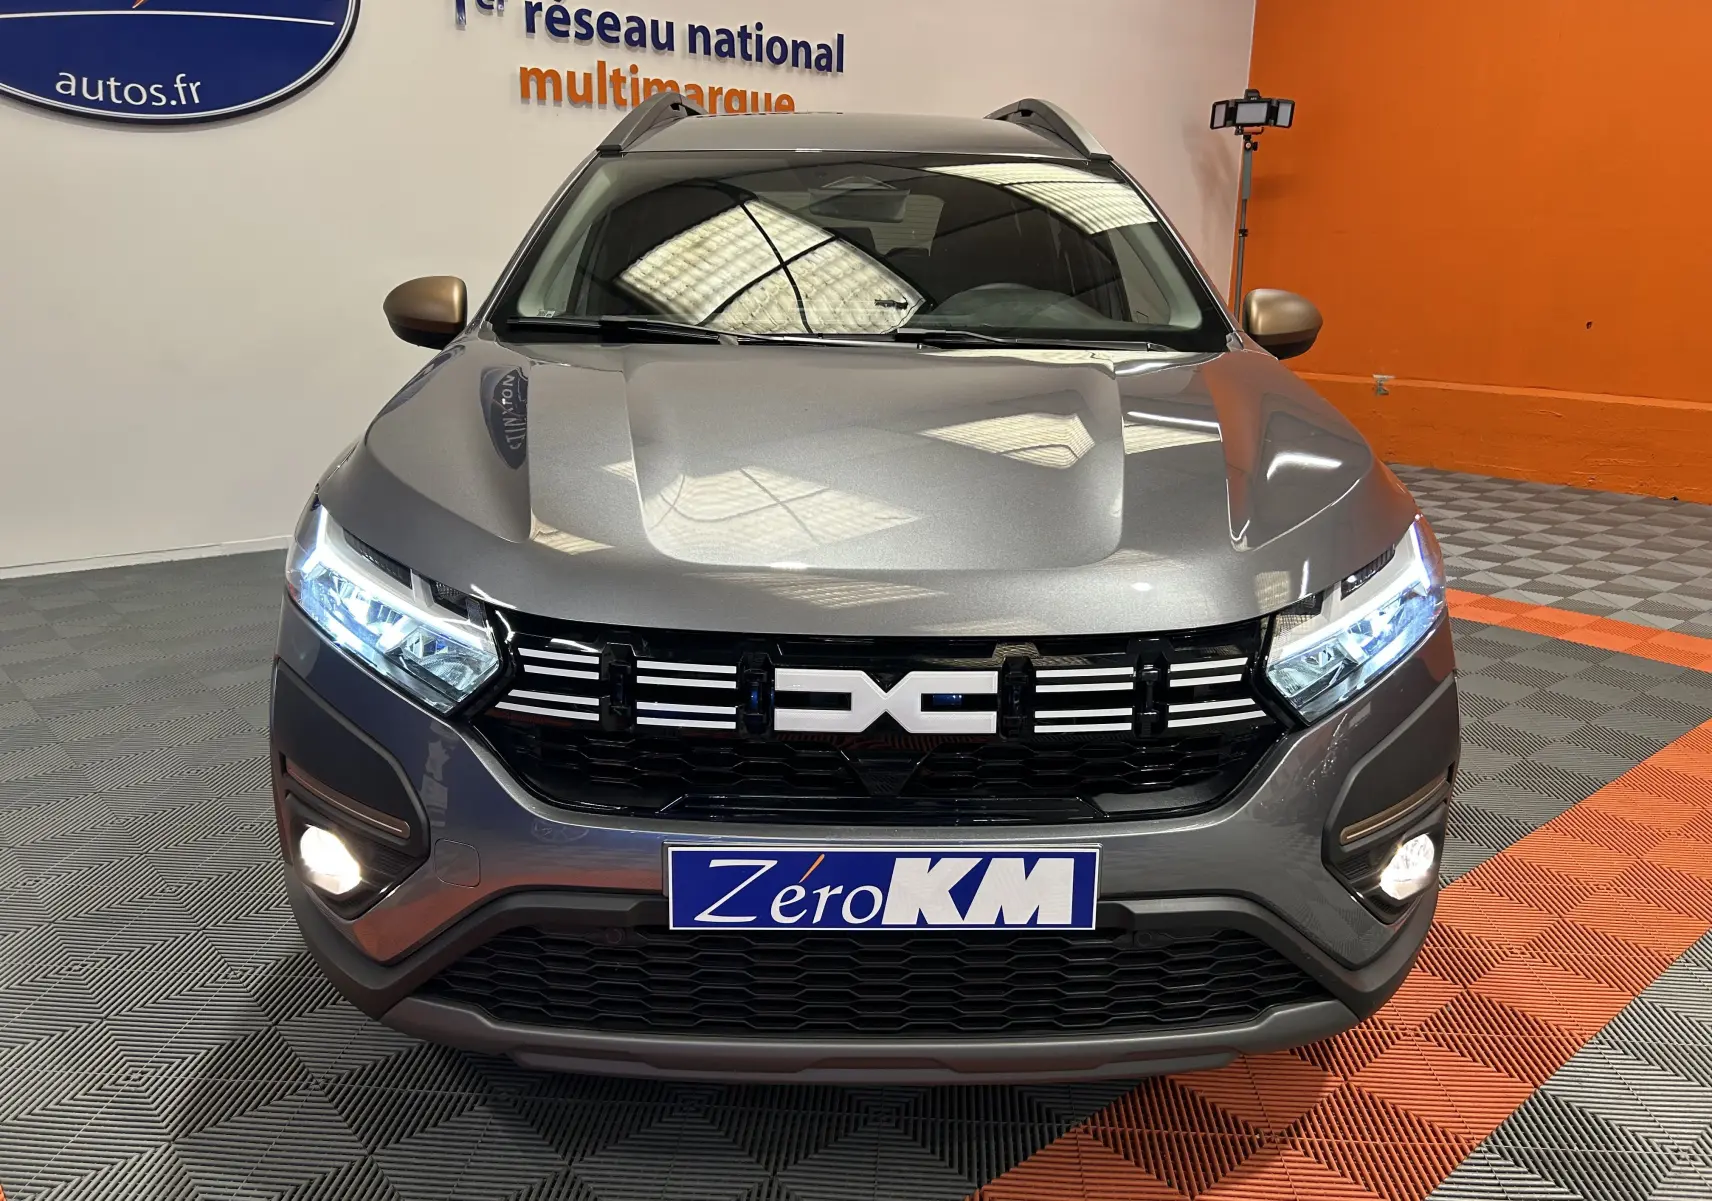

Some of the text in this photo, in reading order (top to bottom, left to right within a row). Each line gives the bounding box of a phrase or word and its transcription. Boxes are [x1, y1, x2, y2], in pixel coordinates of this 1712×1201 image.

[525, 0, 674, 52] réseau
[688, 22, 844, 73] national
[56, 72, 201, 107] autos.fr
